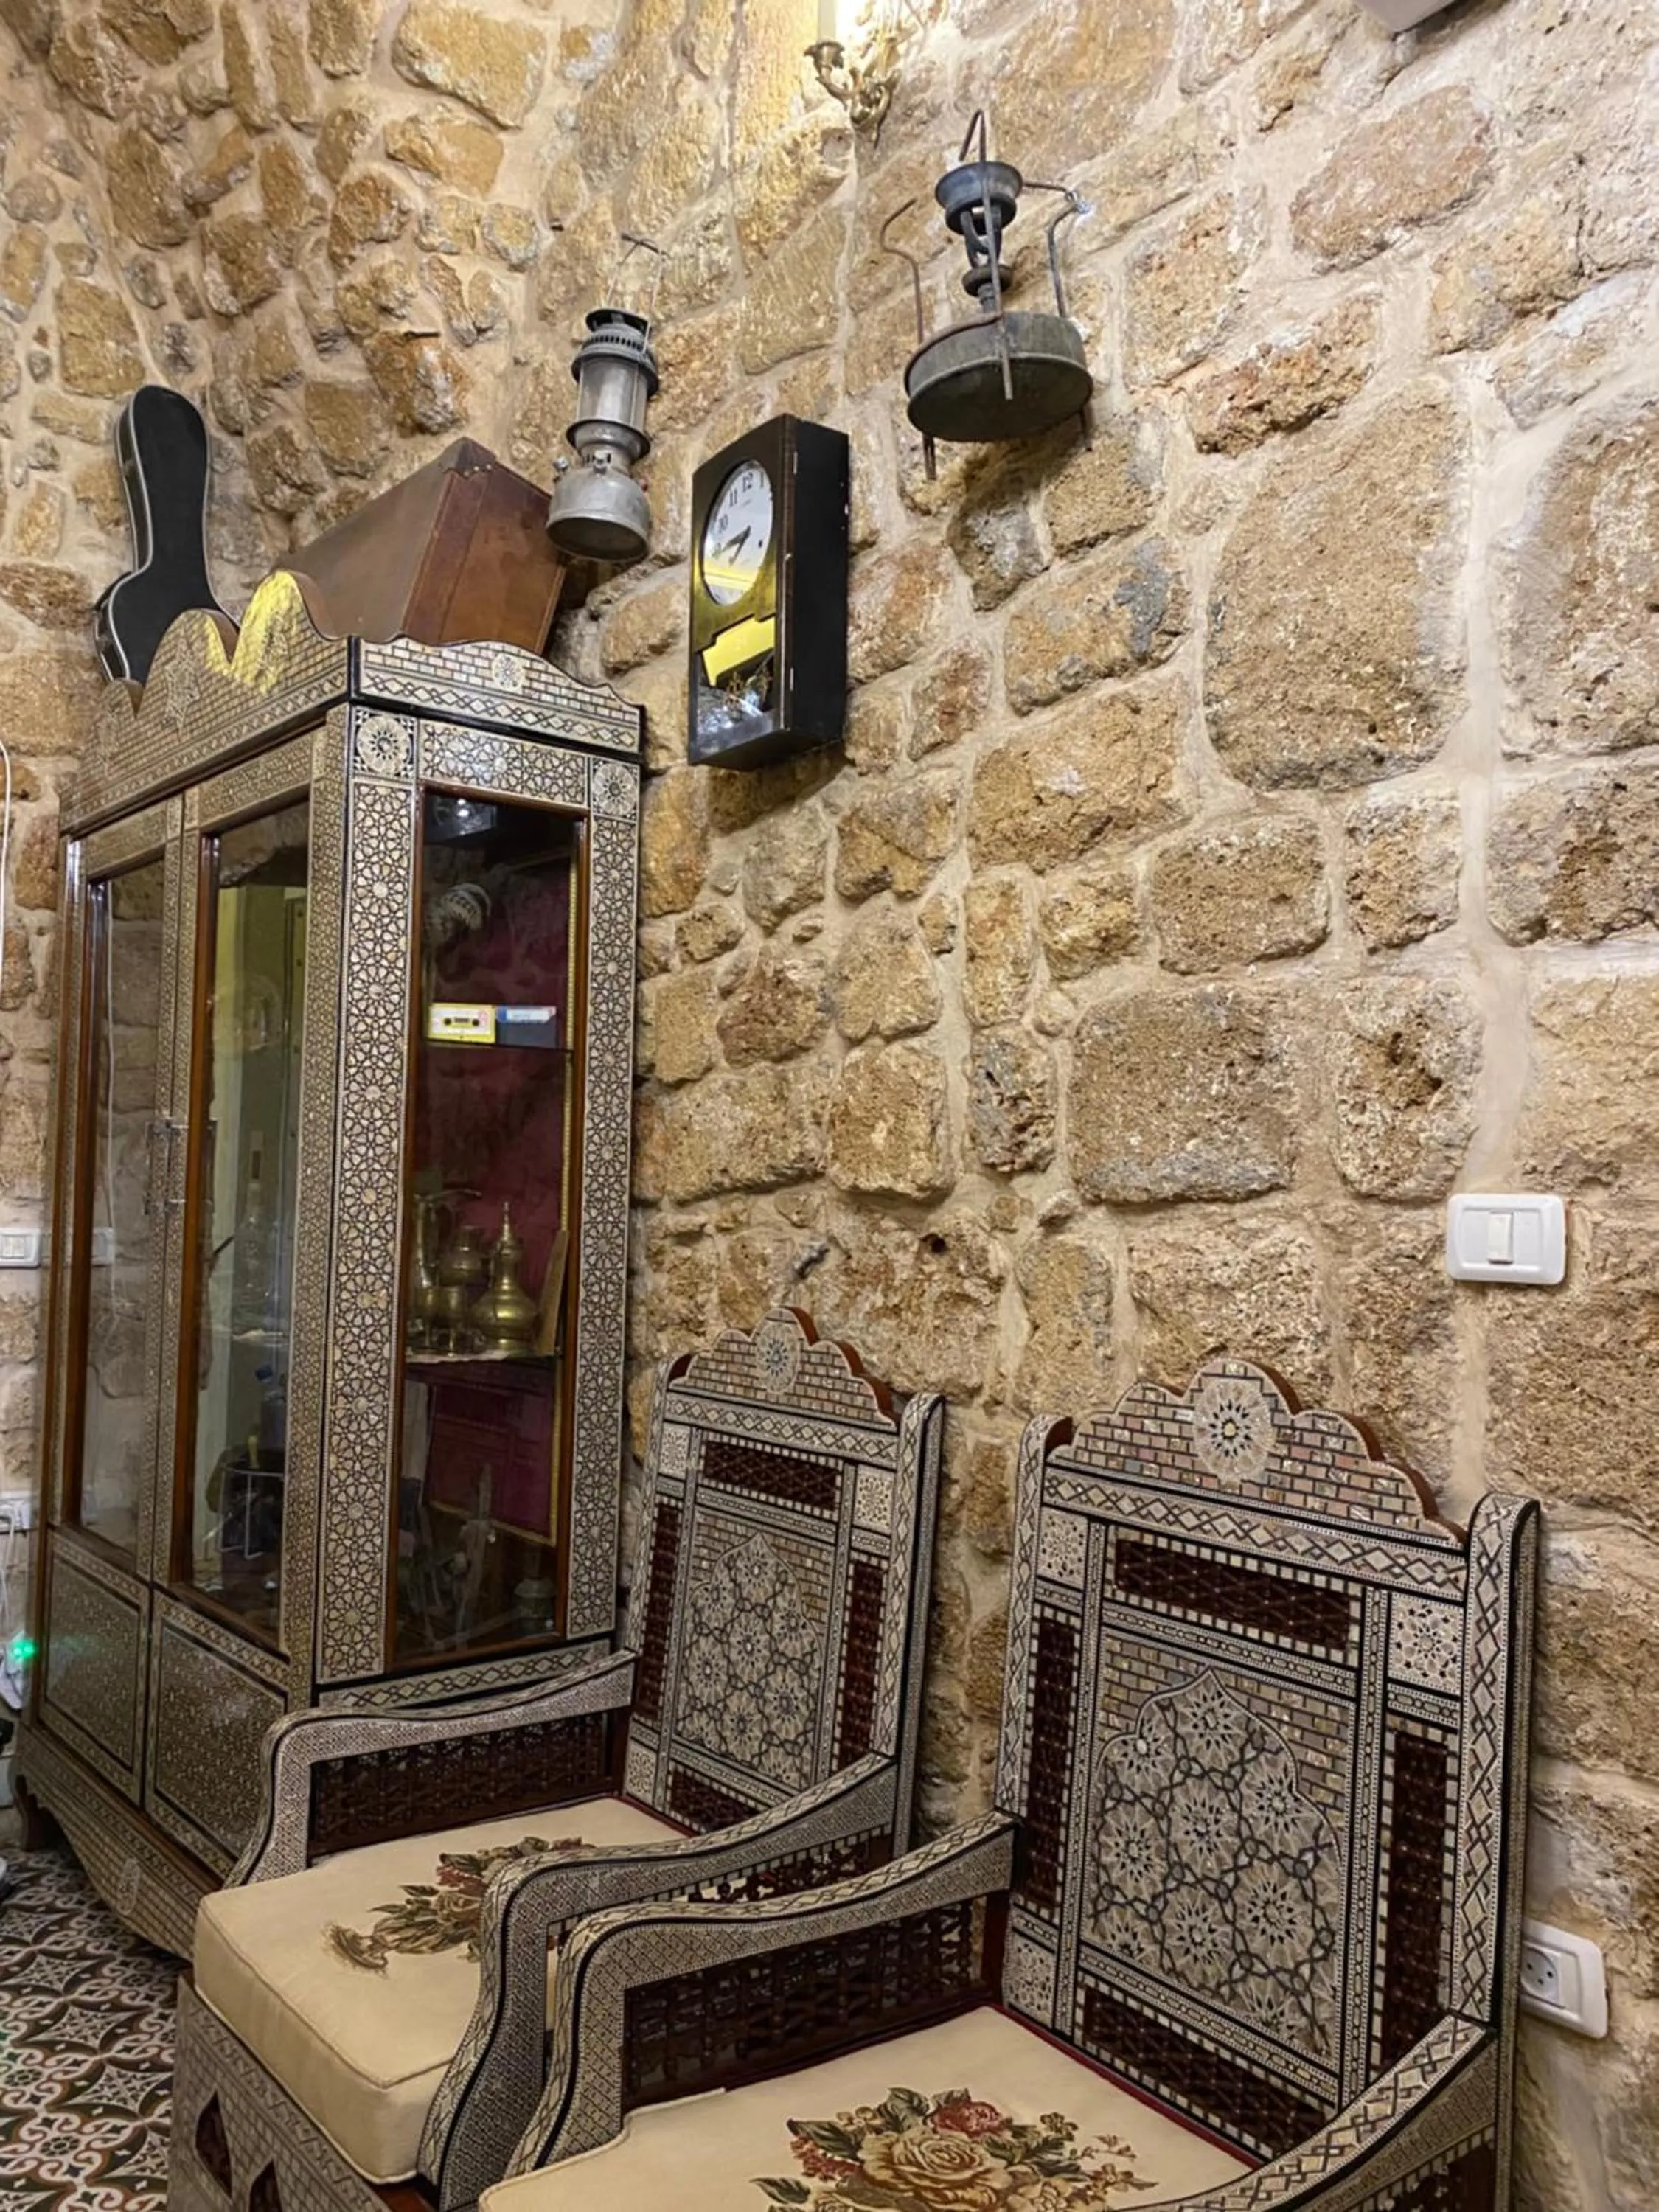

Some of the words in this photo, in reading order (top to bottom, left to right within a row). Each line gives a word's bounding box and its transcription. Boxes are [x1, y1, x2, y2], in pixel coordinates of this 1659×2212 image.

[742, 471, 754, 493] 12
[729, 487, 738, 508] 11
[719, 513, 728, 534] 10
